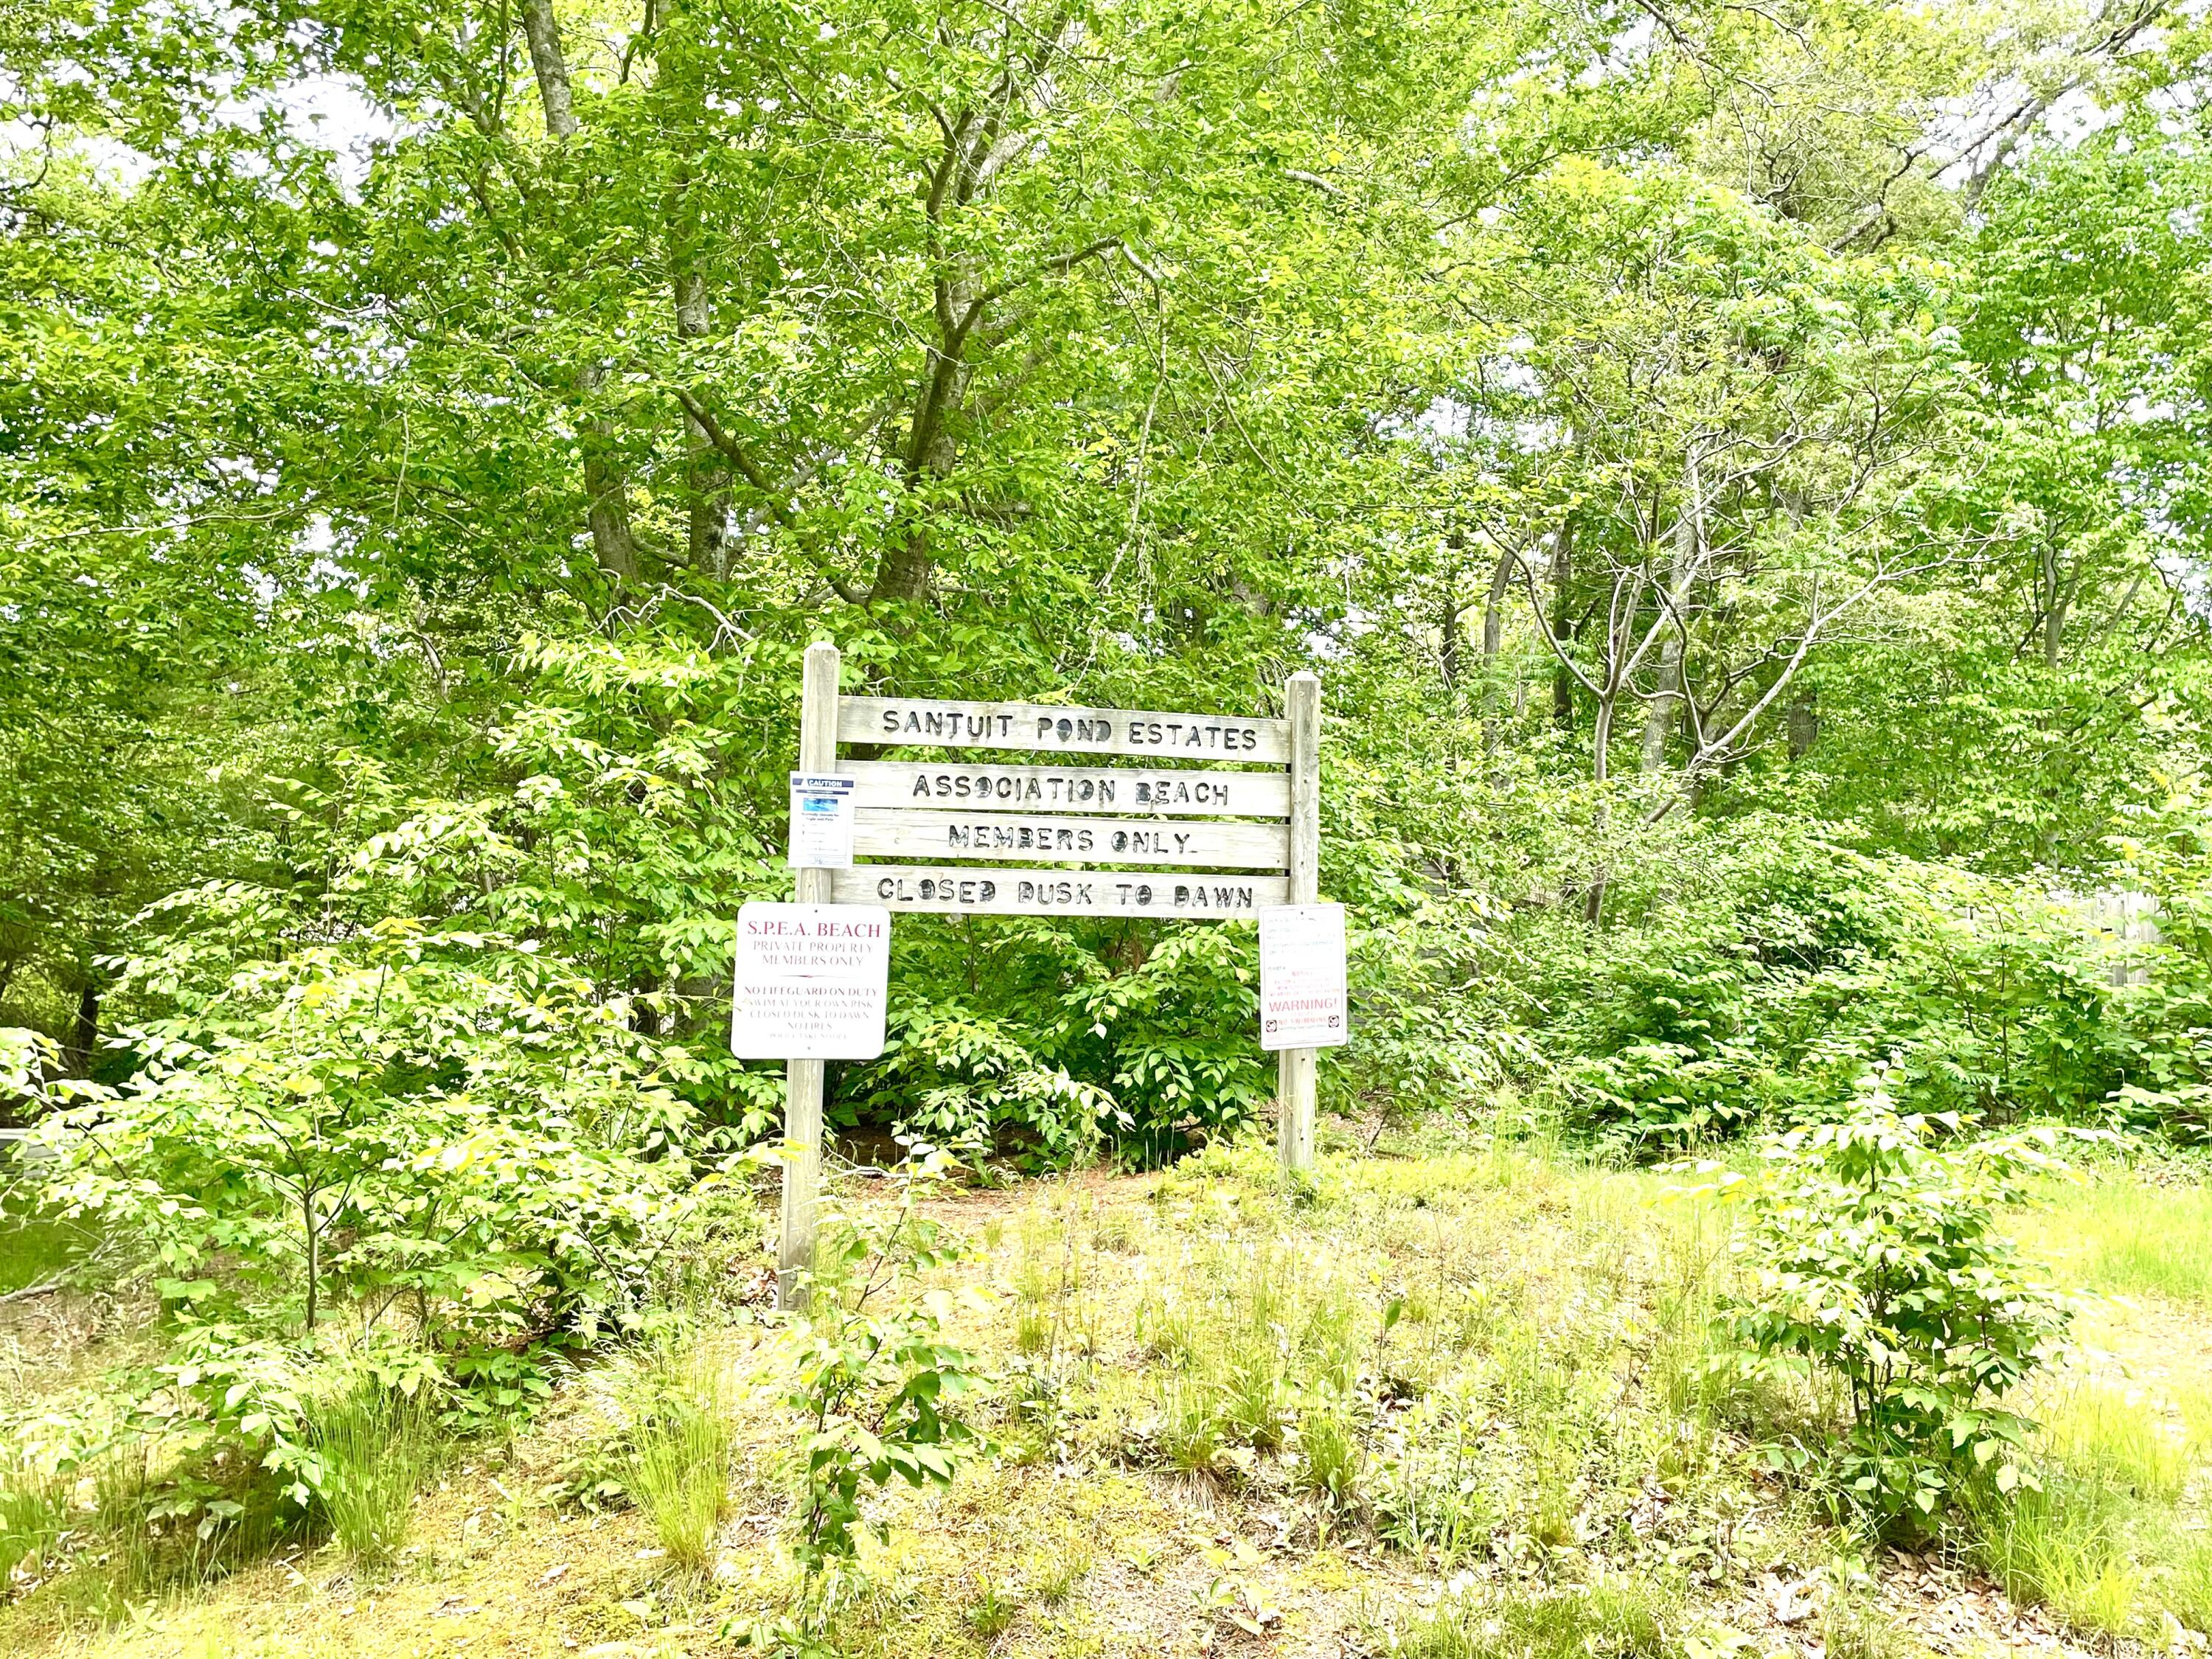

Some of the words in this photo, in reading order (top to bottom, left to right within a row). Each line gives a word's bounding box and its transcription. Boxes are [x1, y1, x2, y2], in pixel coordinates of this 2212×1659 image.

[883, 711, 1014, 738] SANTUIT
[1037, 717, 1111, 742] POND
[1129, 722, 1257, 751] ESTATES
[913, 775, 1116, 804] ASSOCIATION
[1135, 782, 1228, 806] BEACH
[949, 825, 1094, 851] MEMBERS
[1111, 831, 1191, 854] ONLY
[877, 877, 996, 904] CLOSED
[1018, 881, 1093, 905] DUSK
[1116, 884, 1153, 906] TO
[1175, 886, 1253, 908] DAWN
[748, 920, 811, 936] S.P.E.A.
[817, 922, 880, 938] BEACH
[754, 940, 803, 951] PRIVATE
[810, 942, 873, 953] PROPERTY
[762, 955, 826, 966] MEMBERS
[830, 956, 863, 967] ONLY
[745, 986, 760, 995] NO
[762, 987, 827, 995] LIFEGUARD
[830, 987, 845, 996] ON
[848, 988, 877, 997] DUTY
[824, 1000, 847, 1008] OWN
[851, 1000, 873, 1009] RISK
[1268, 998, 1338, 1013] WARNING!
[750, 1011, 790, 1019] CLOSED
[793, 1011, 820, 1019] DUSK
[824, 1011, 836, 1019] TO
[839, 1011, 869, 1020] DAWN
[787, 1022, 802, 1030] NO
